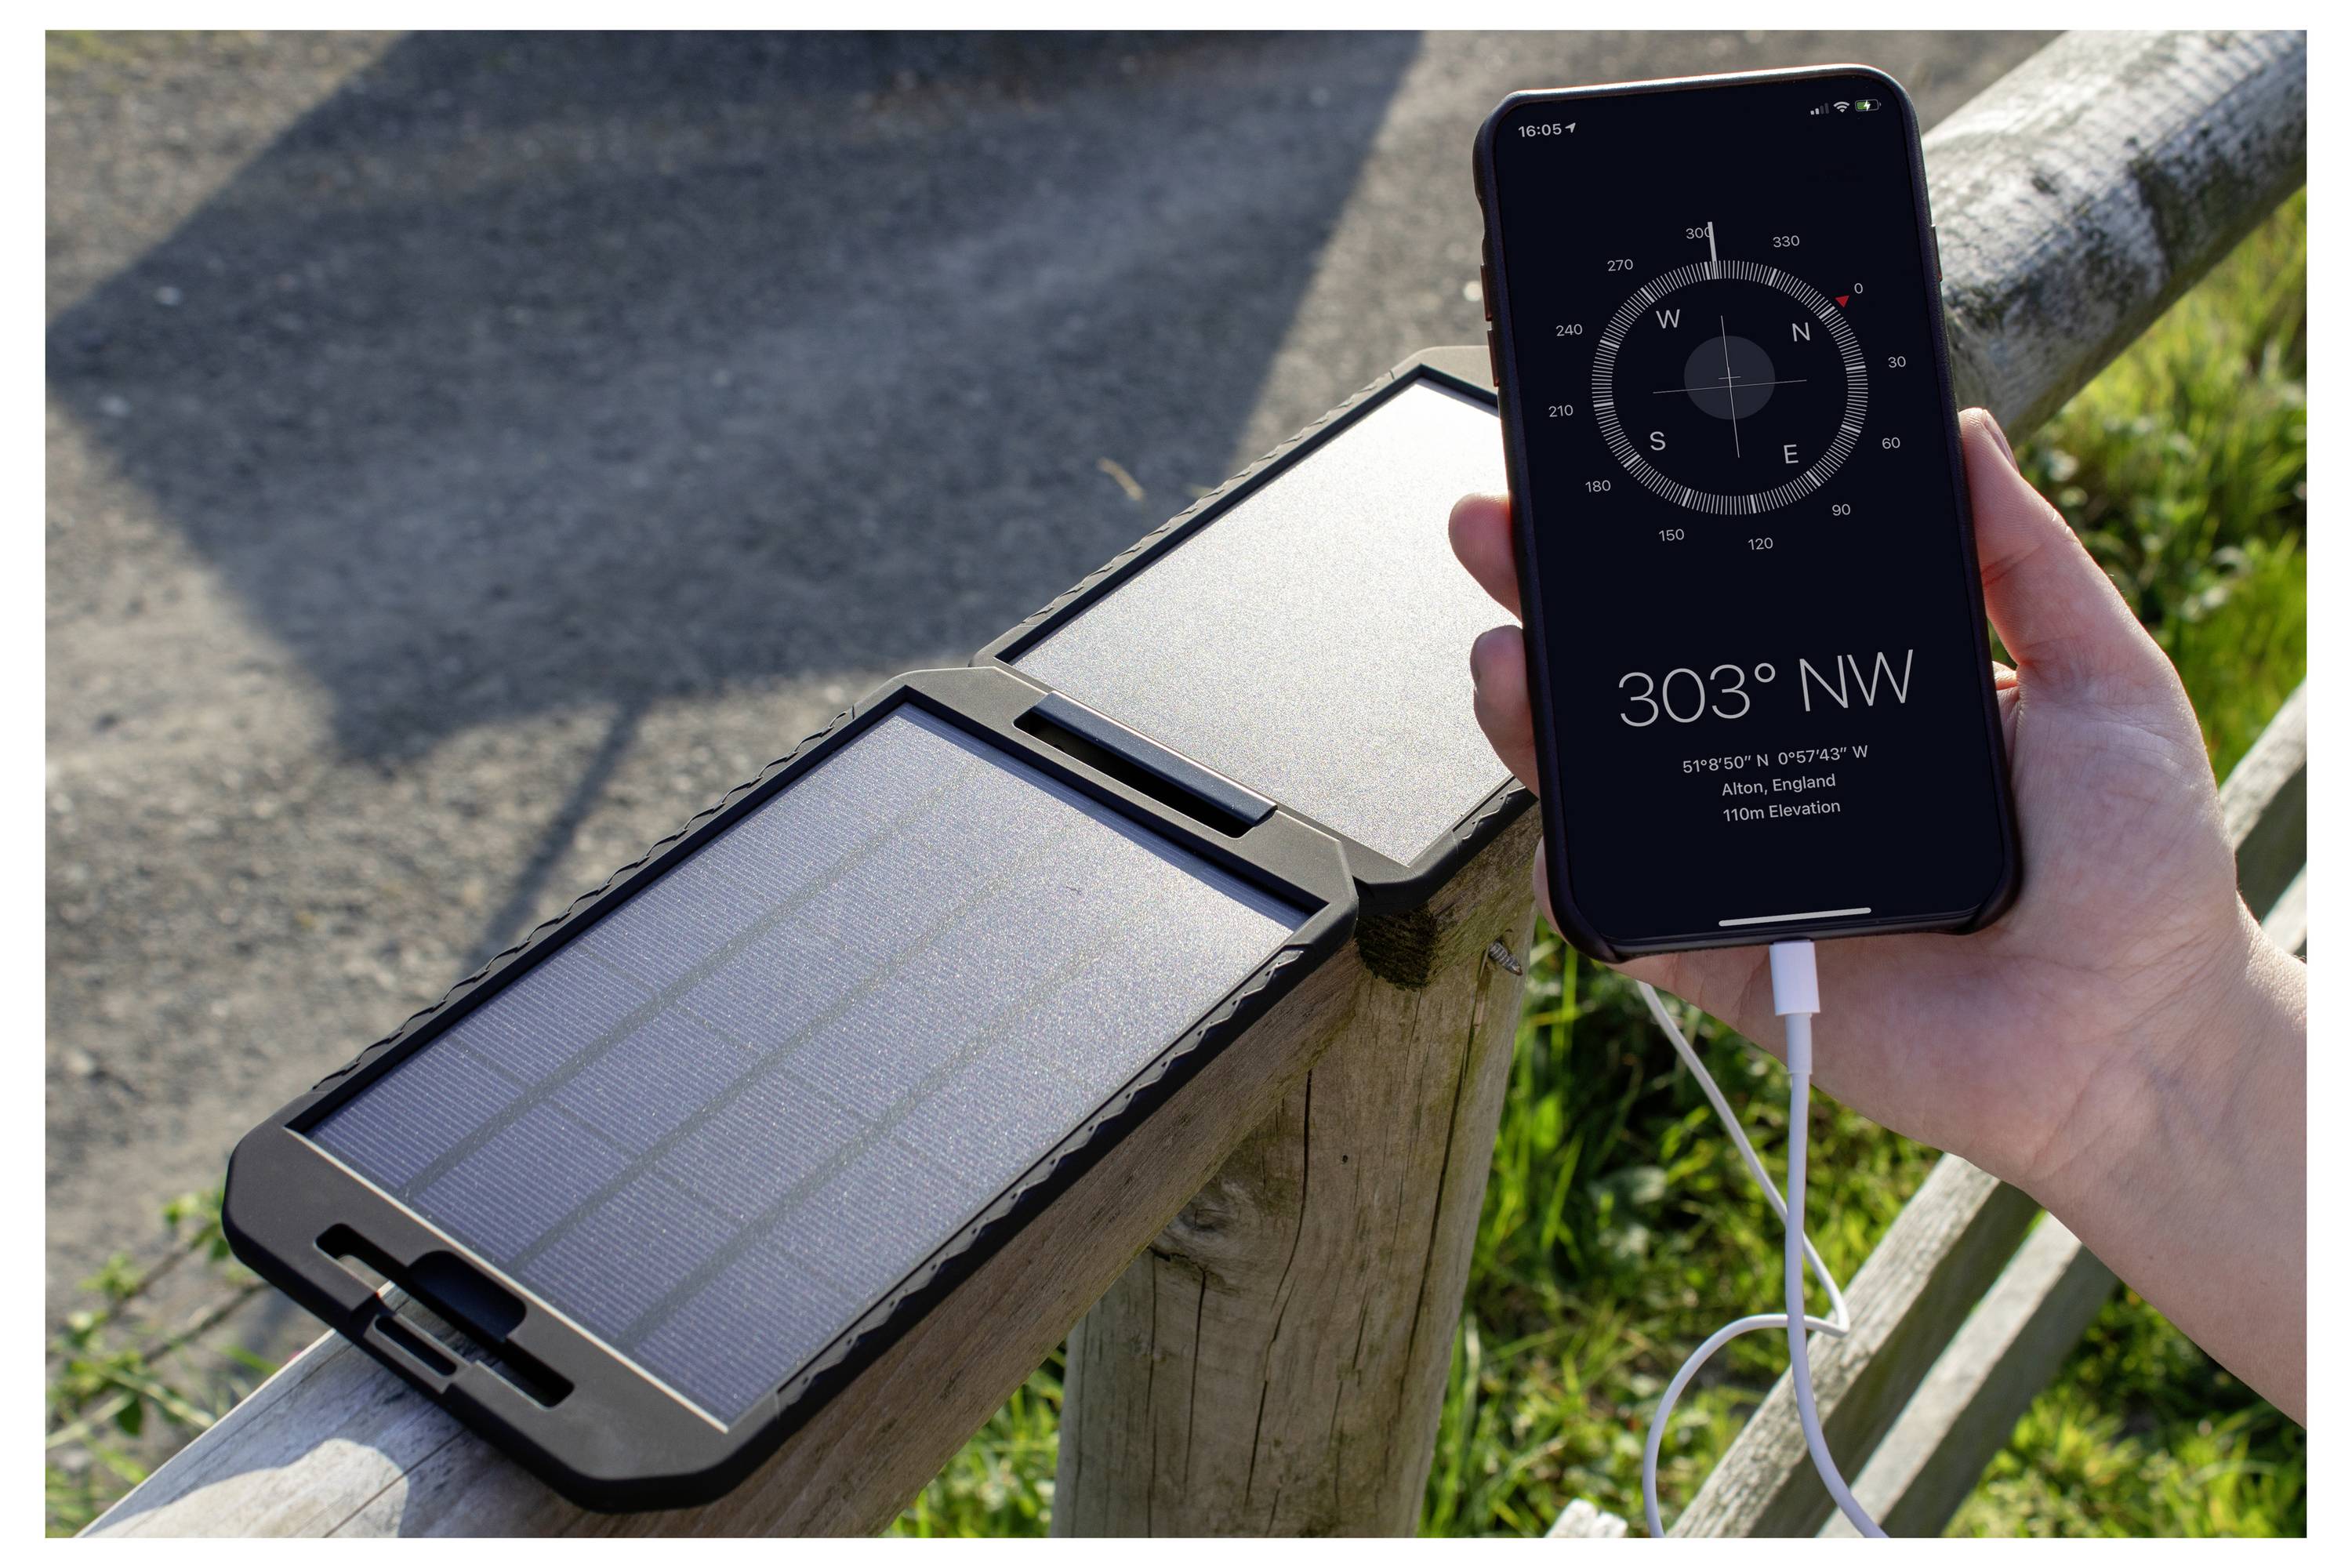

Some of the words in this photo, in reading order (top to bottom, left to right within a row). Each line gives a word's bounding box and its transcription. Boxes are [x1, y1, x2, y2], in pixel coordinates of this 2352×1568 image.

[1518, 123, 1562, 138] 16:05
[1773, 234, 1800, 248] 330
[1607, 259, 1634, 272] 270
[1853, 282, 1864, 294] 0
[1655, 308, 1680, 329] W
[1555, 323, 1583, 337] 240
[1791, 321, 1811, 342] N
[1888, 356, 1907, 368] 30
[1548, 404, 1573, 418] 210
[1650, 430, 1666, 451] S
[1882, 437, 1900, 449] 60
[1783, 444, 1799, 464] E
[1584, 479, 1611, 493] 180
[1831, 503, 1851, 517] 90
[1658, 528, 1685, 542] 150
[1748, 537, 1773, 550] 120
[1618, 662, 1776, 728] 303°
[1798, 648, 1914, 712] NW
[1756, 753, 1769, 768] N
[1852, 745, 1868, 759] W
[1722, 782, 1768, 797] Alton,
[1772, 773, 1836, 793] England
[1722, 807, 1765, 822] 110m
[1769, 800, 1841, 818] Elevation
